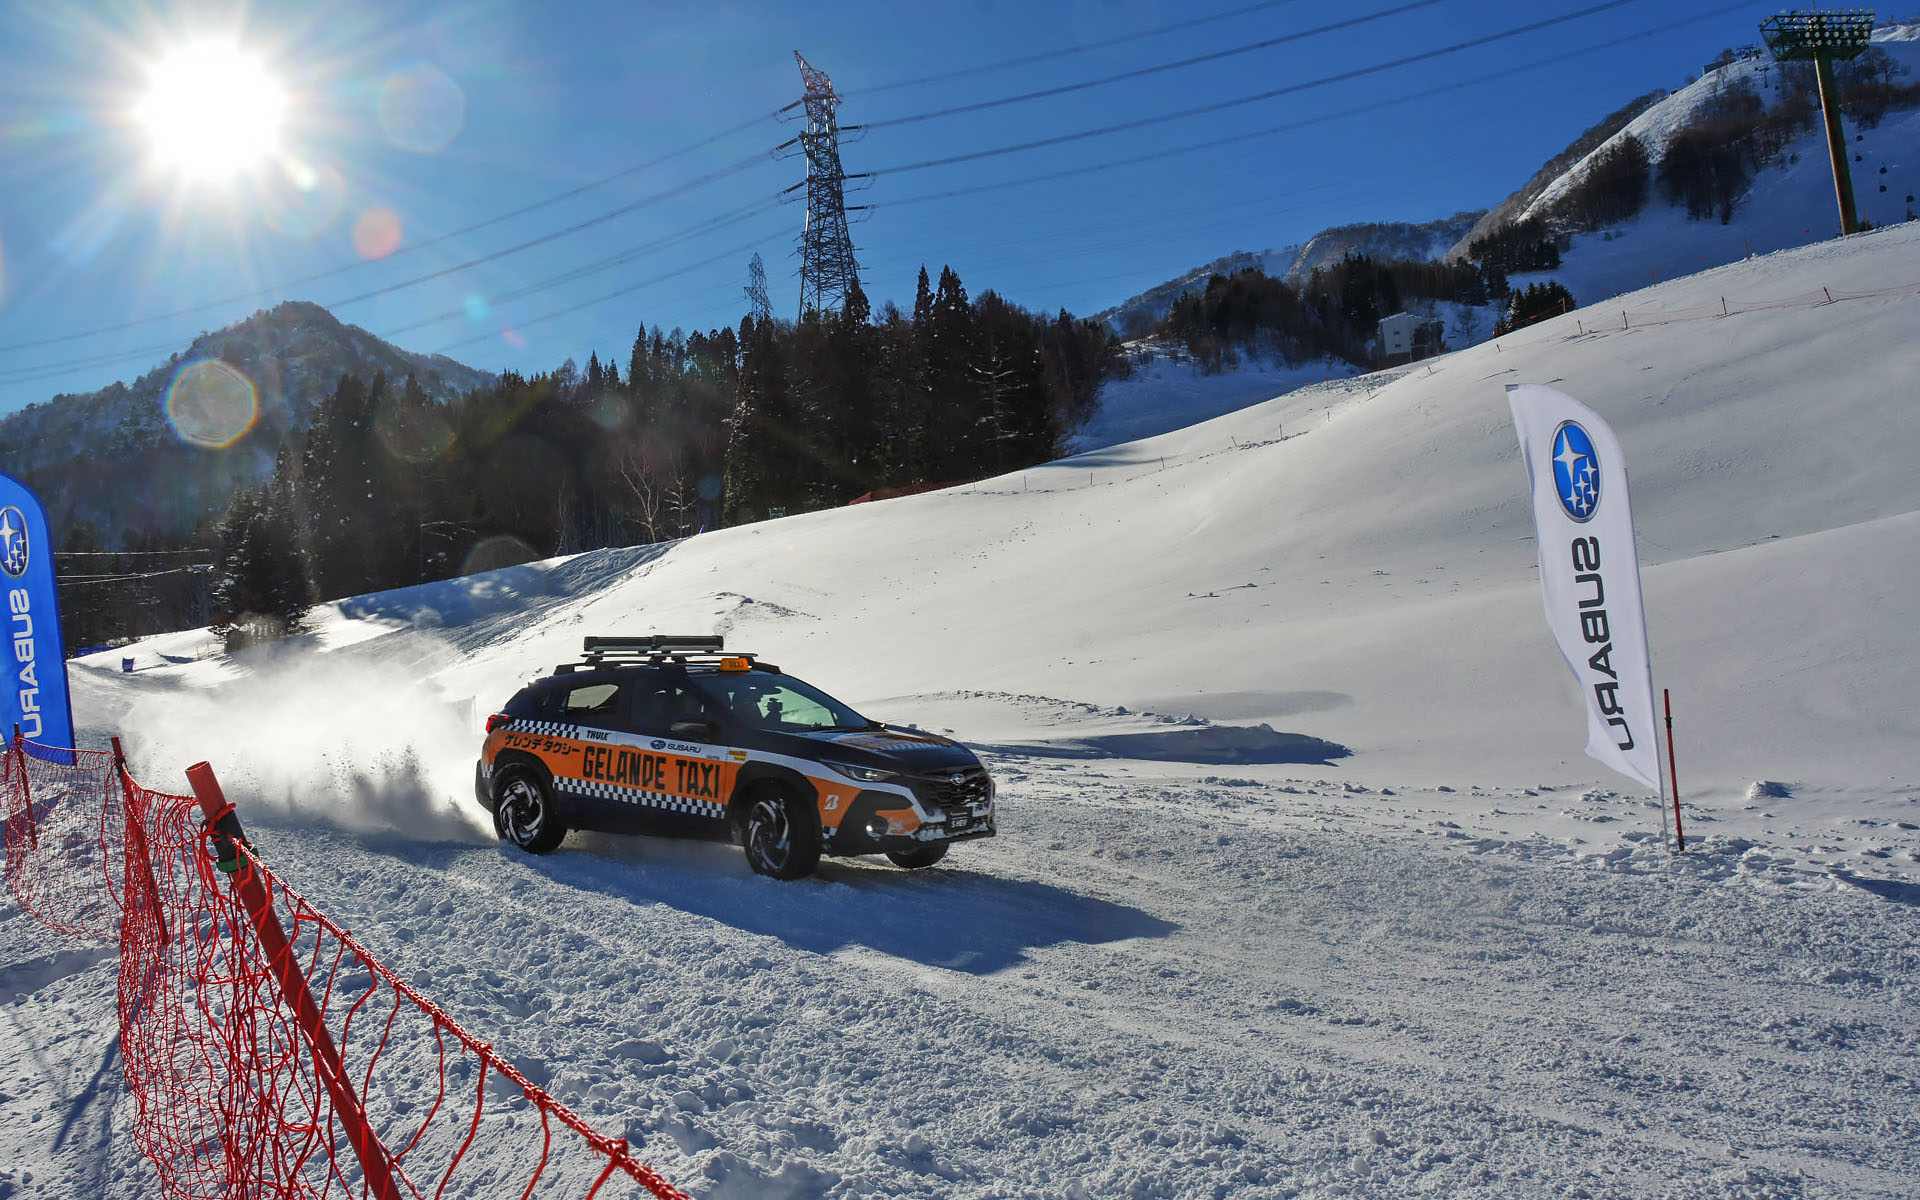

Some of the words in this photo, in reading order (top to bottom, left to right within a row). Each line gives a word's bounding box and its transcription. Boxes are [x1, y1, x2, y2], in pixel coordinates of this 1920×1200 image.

[586, 730, 609, 741] THULE
[667, 743, 702, 754] SUBARU
[676, 759, 721, 799] TAXI
